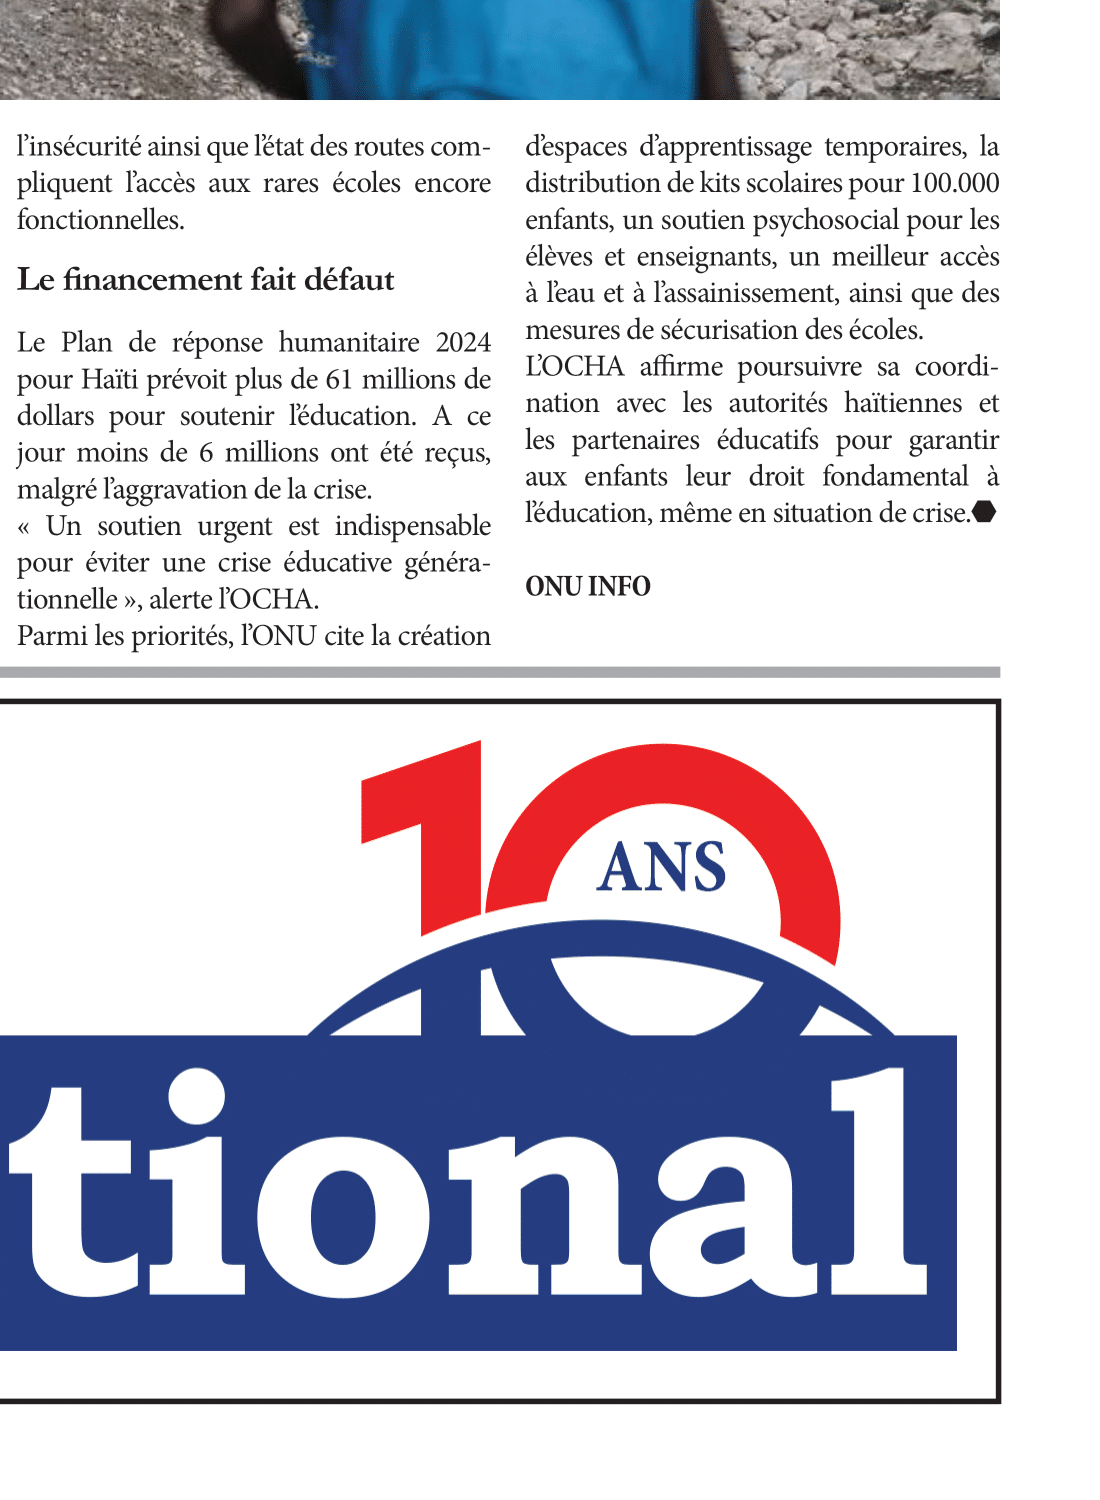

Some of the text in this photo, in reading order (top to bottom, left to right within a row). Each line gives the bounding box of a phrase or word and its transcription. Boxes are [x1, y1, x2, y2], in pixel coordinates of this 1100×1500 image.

[526, 134, 999, 163] d’espaces d’apprentissage temporaires, la
[17, 170, 491, 199] pliquent l’accès aux rares écoles encore
[17, 266, 394, 290] Le financement fait défaut
[18, 330, 491, 359] Le Plan de réponse humanitaire 2024
[526, 354, 998, 383] L’OCHA affirme poursuivre sa coordi-
[526, 464, 999, 486] aux enfants leur droit fondamental à
[526, 575, 650, 596] ONU INFO
[596, 841, 725, 891] ANS
